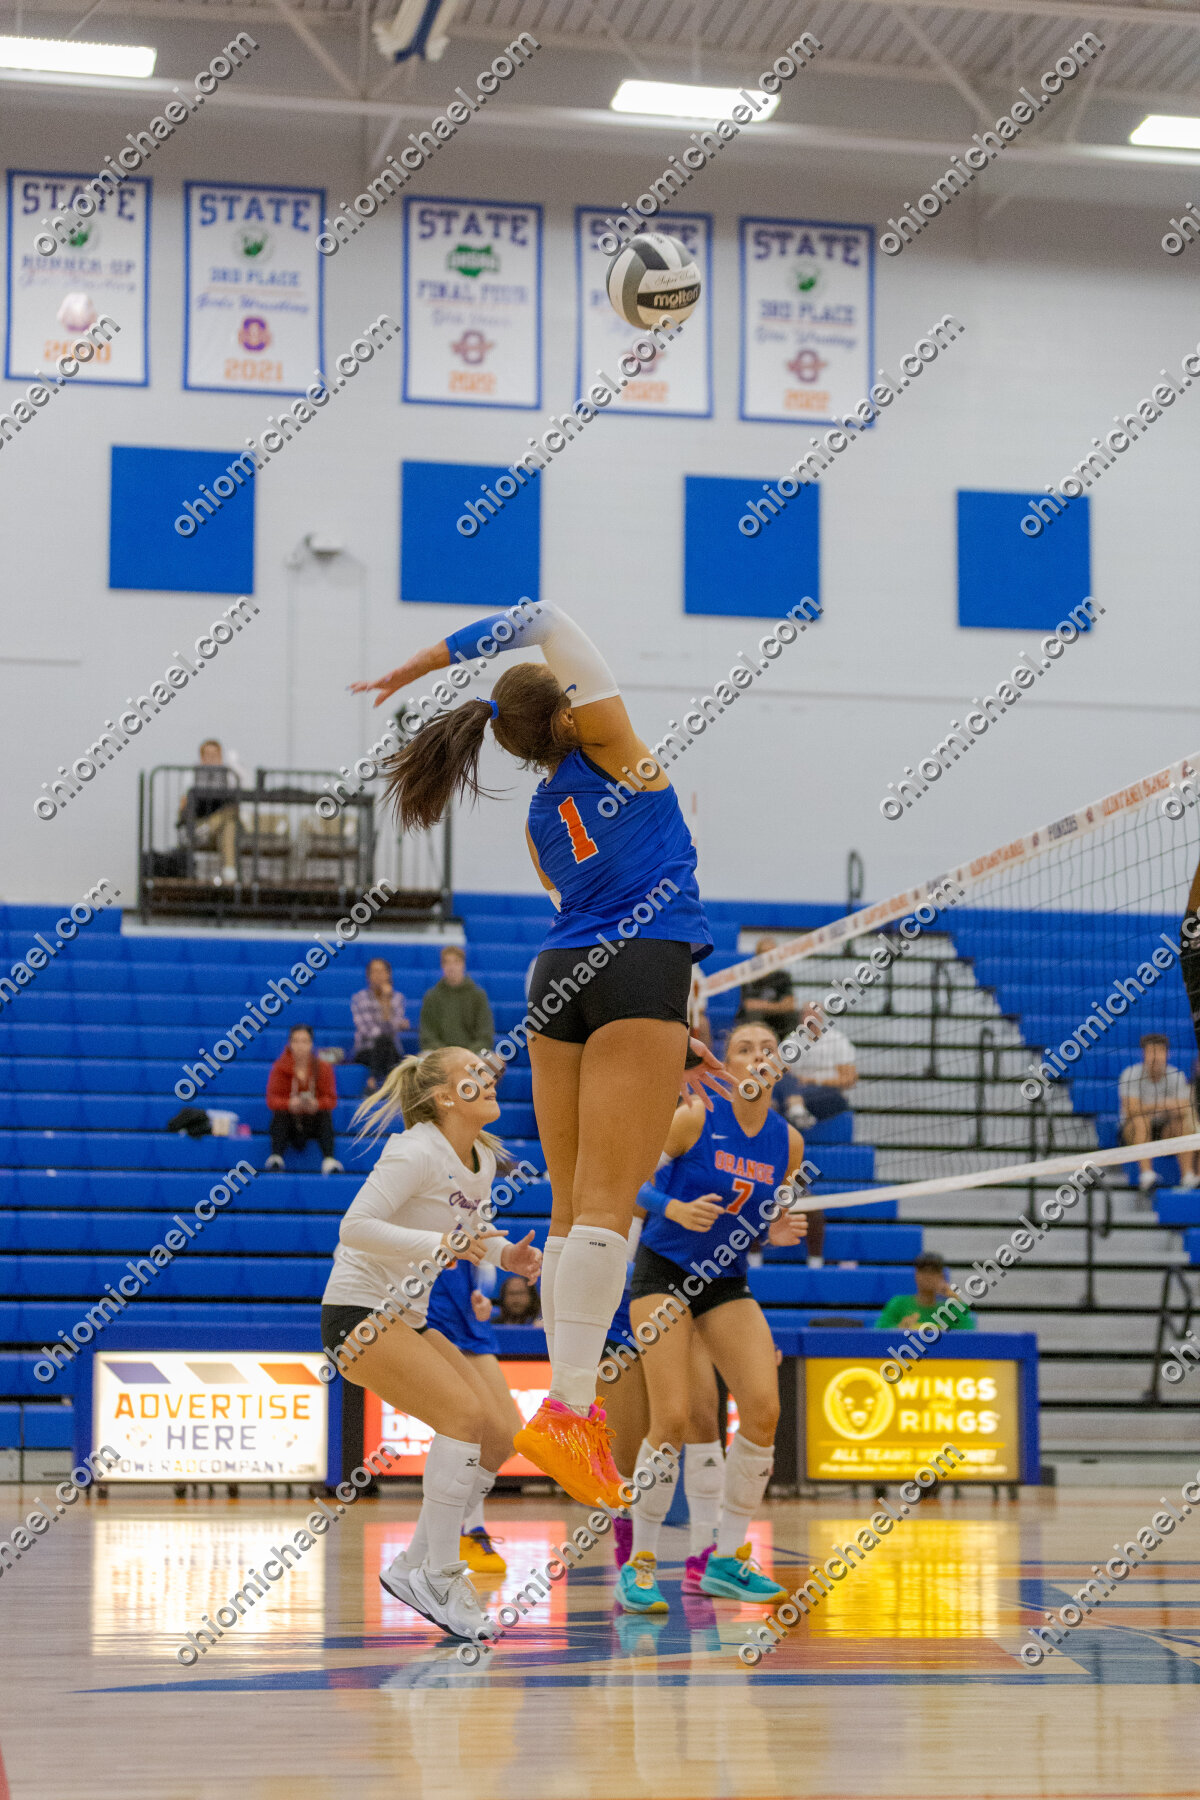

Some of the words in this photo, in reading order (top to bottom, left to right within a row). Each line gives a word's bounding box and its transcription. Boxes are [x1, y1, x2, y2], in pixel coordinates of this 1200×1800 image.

[200, 193, 310, 232] STATE
[418, 208, 528, 246] STATE
[753, 229, 860, 268] STATE
[653, 287, 698, 307] molten
[44, 340, 111, 363] 200
[224, 357, 283, 383] 2021
[558, 796, 599, 864] 1
[714, 1150, 775, 1185] ORANGE
[725, 1177, 755, 1215] 7
[896, 1377, 998, 1401] WINGS
[114, 1393, 310, 1420] ADVERTISE
[899, 1410, 998, 1434] RINGS
[166, 1425, 256, 1450] HERE
